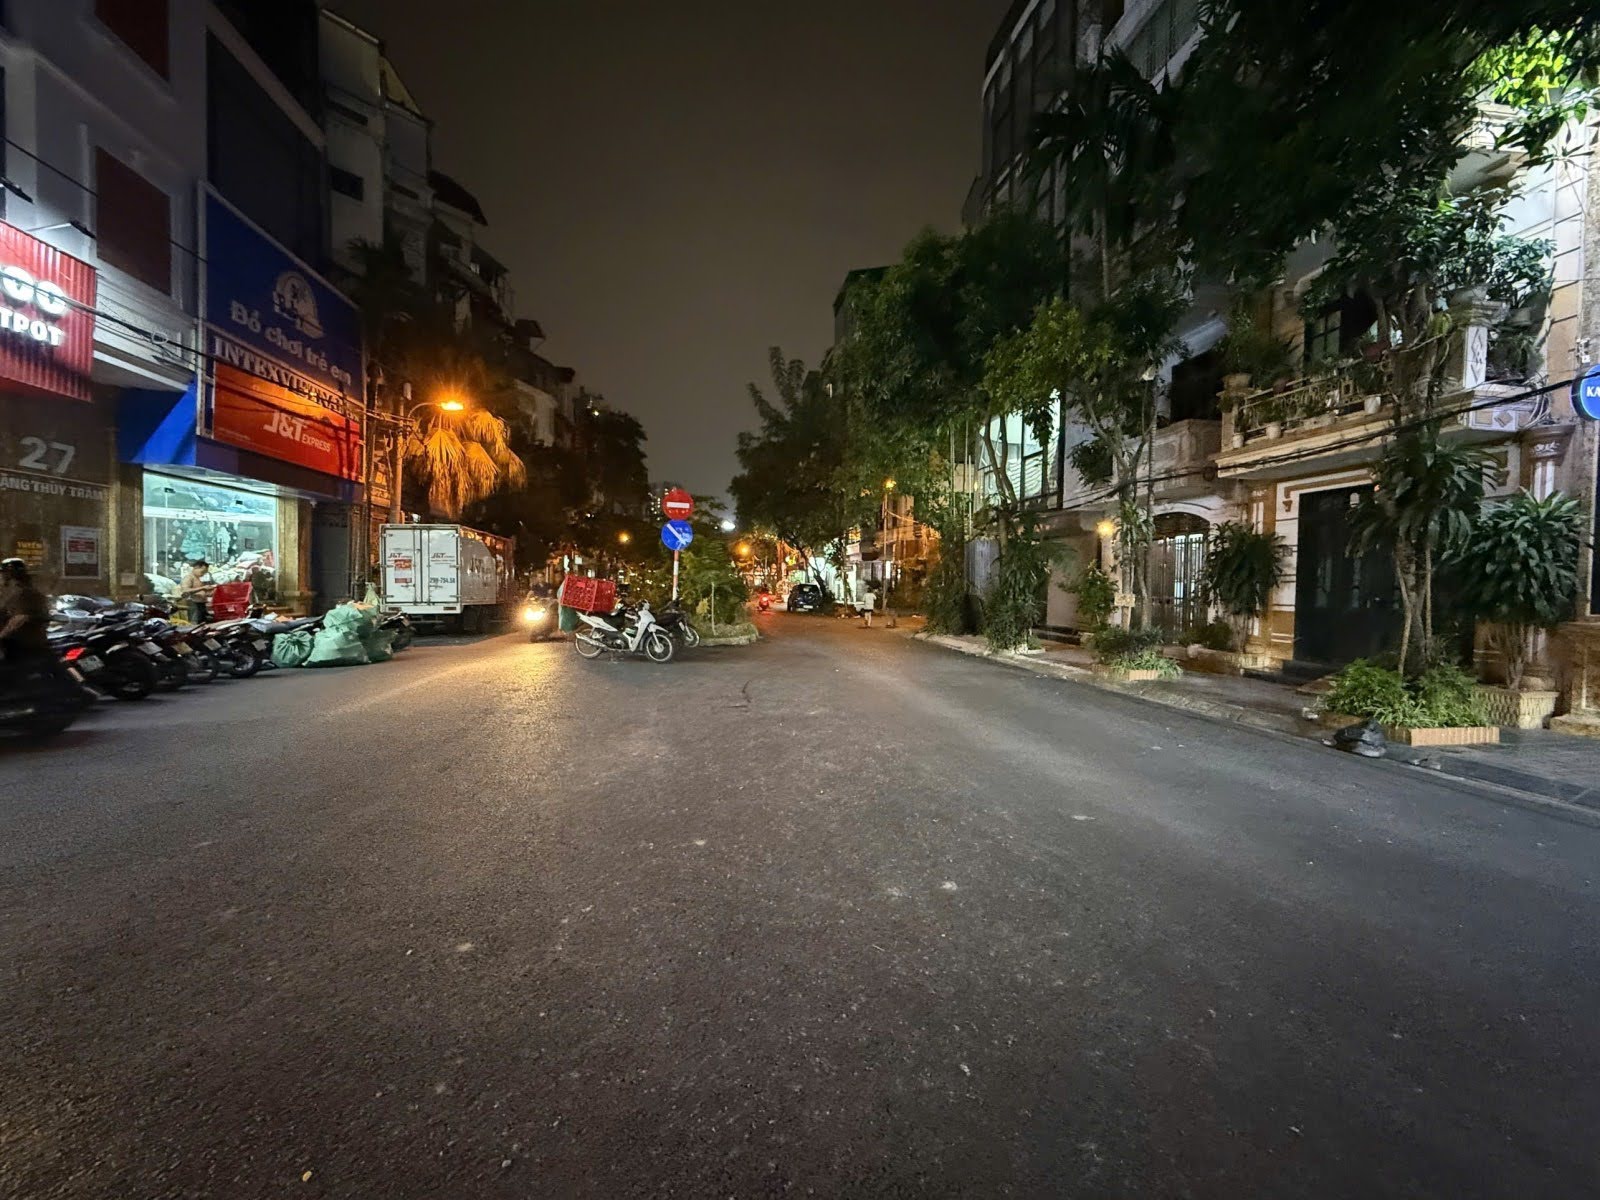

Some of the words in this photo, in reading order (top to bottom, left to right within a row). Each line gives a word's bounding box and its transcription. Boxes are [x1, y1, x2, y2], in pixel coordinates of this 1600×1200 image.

[263, 410, 305, 442] J&T
[302, 433, 331, 453] EXPRESS
[19, 436, 75, 475] 27
